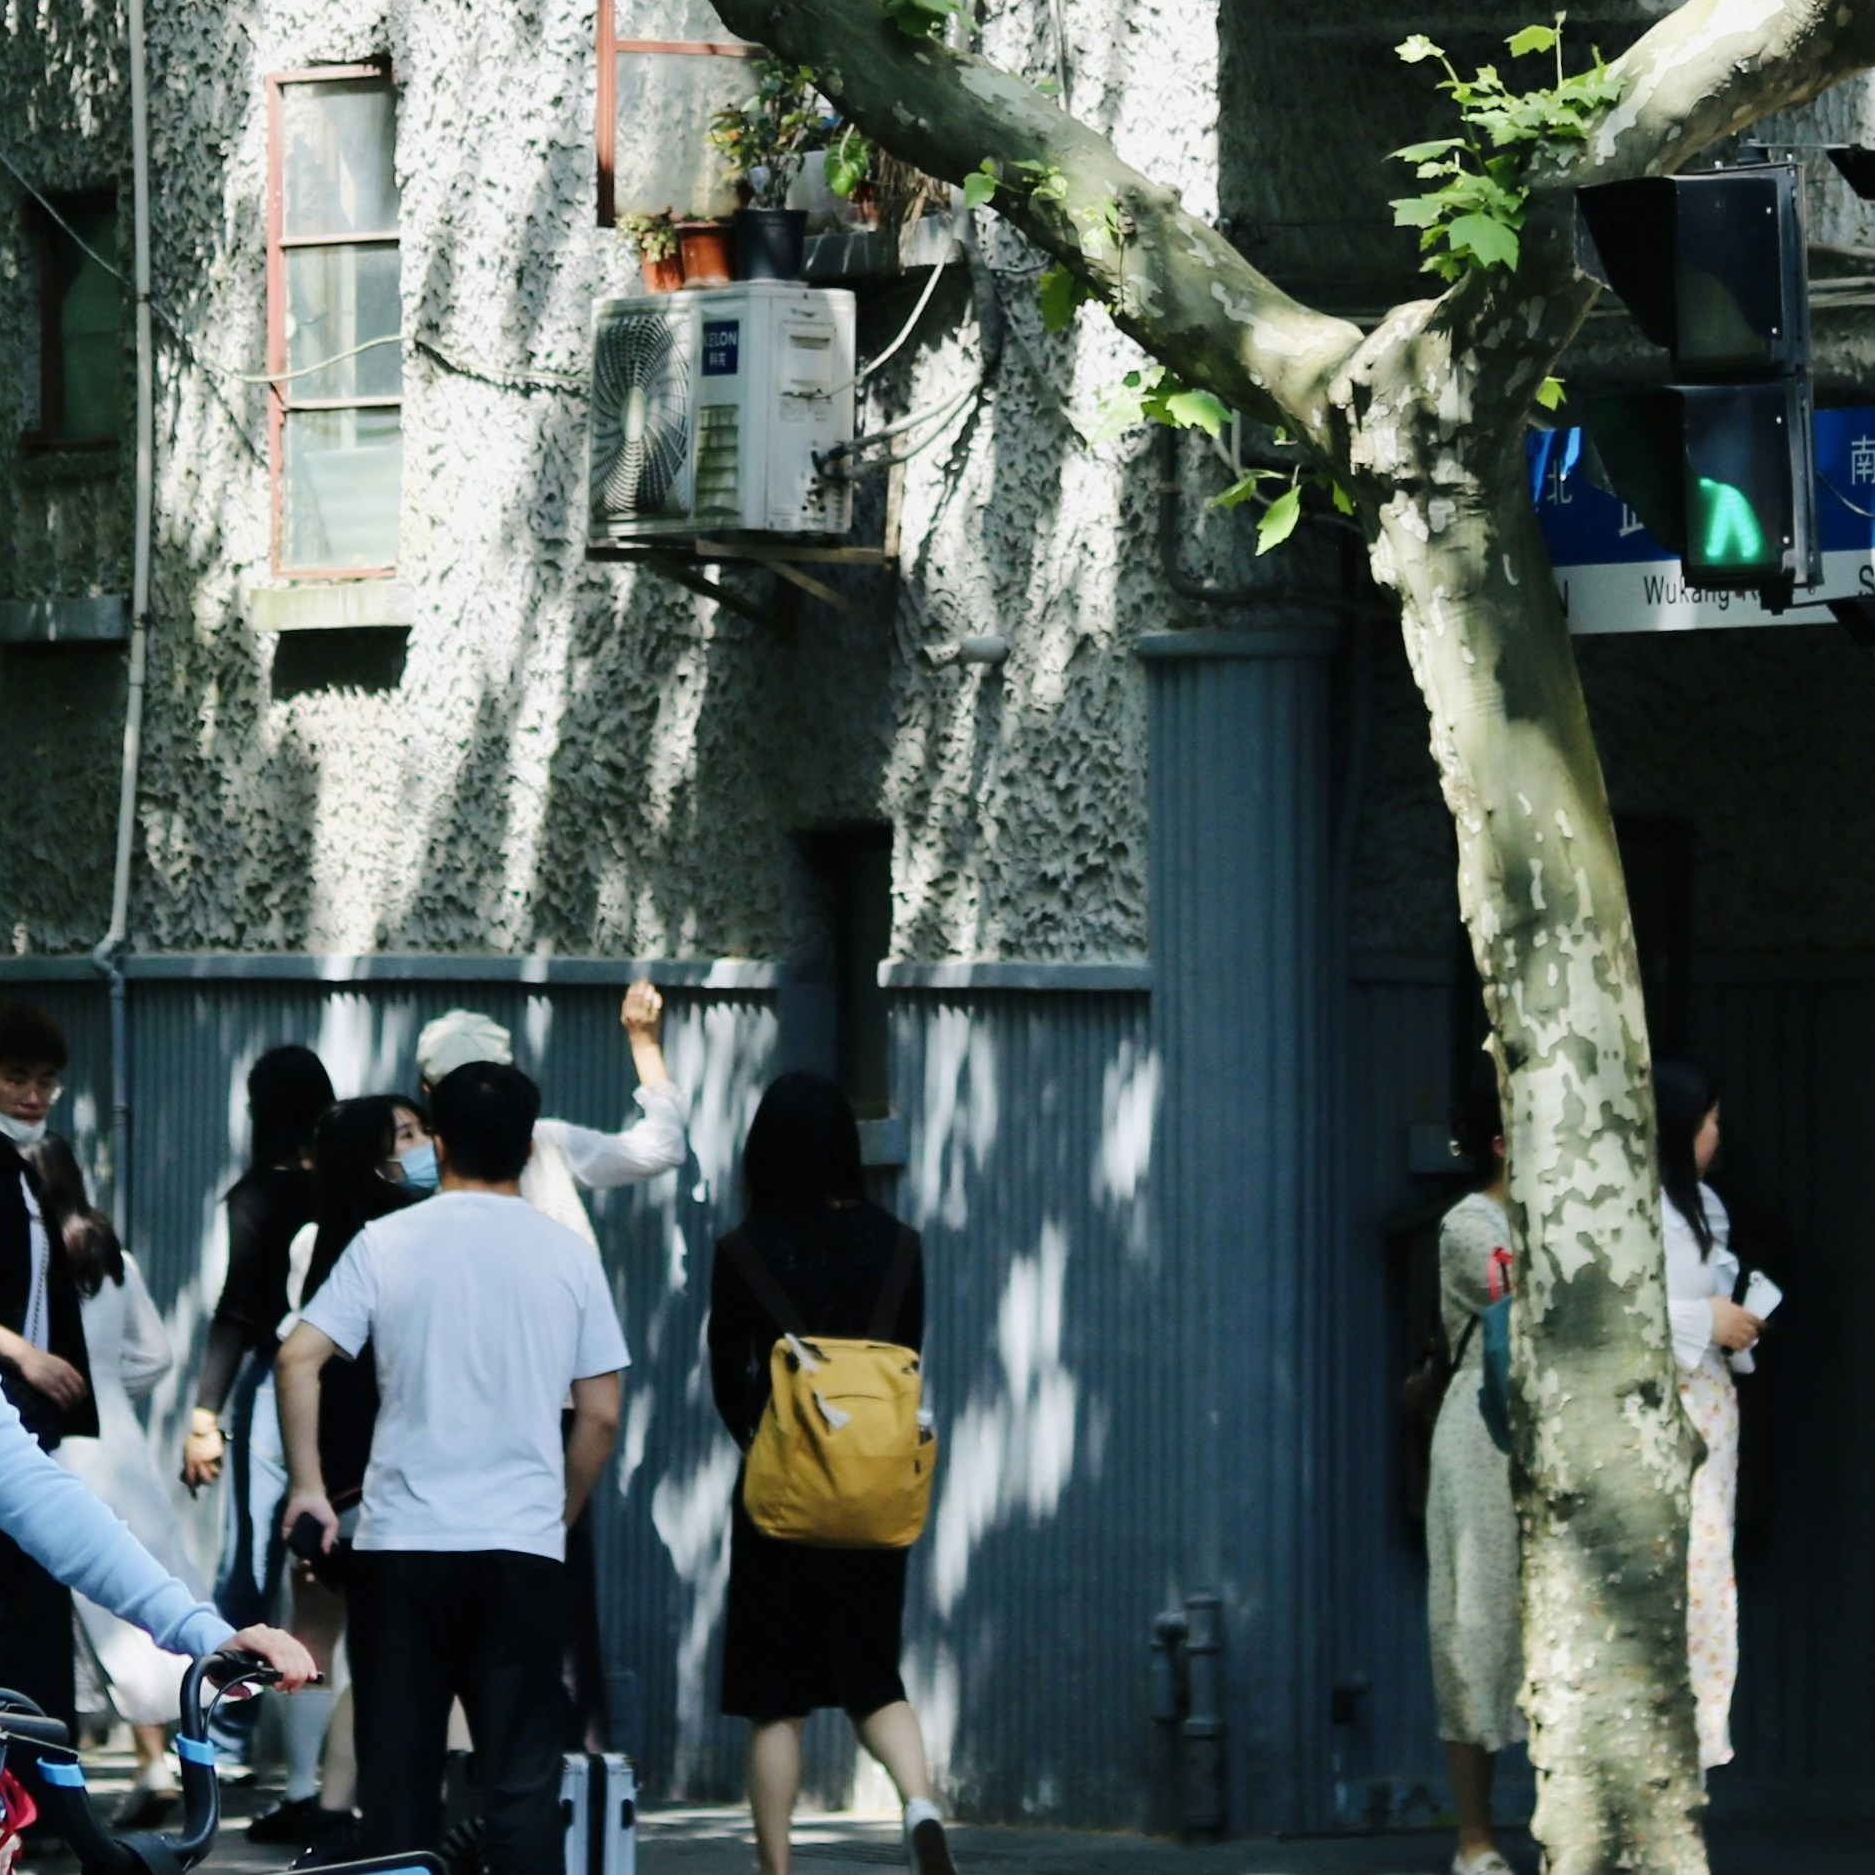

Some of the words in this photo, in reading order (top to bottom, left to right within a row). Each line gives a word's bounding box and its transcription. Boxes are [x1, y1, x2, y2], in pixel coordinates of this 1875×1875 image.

[1546, 459, 1573, 506] 北
[1644, 575, 1729, 610] Wukang
[1858, 564, 1875, 597] S
